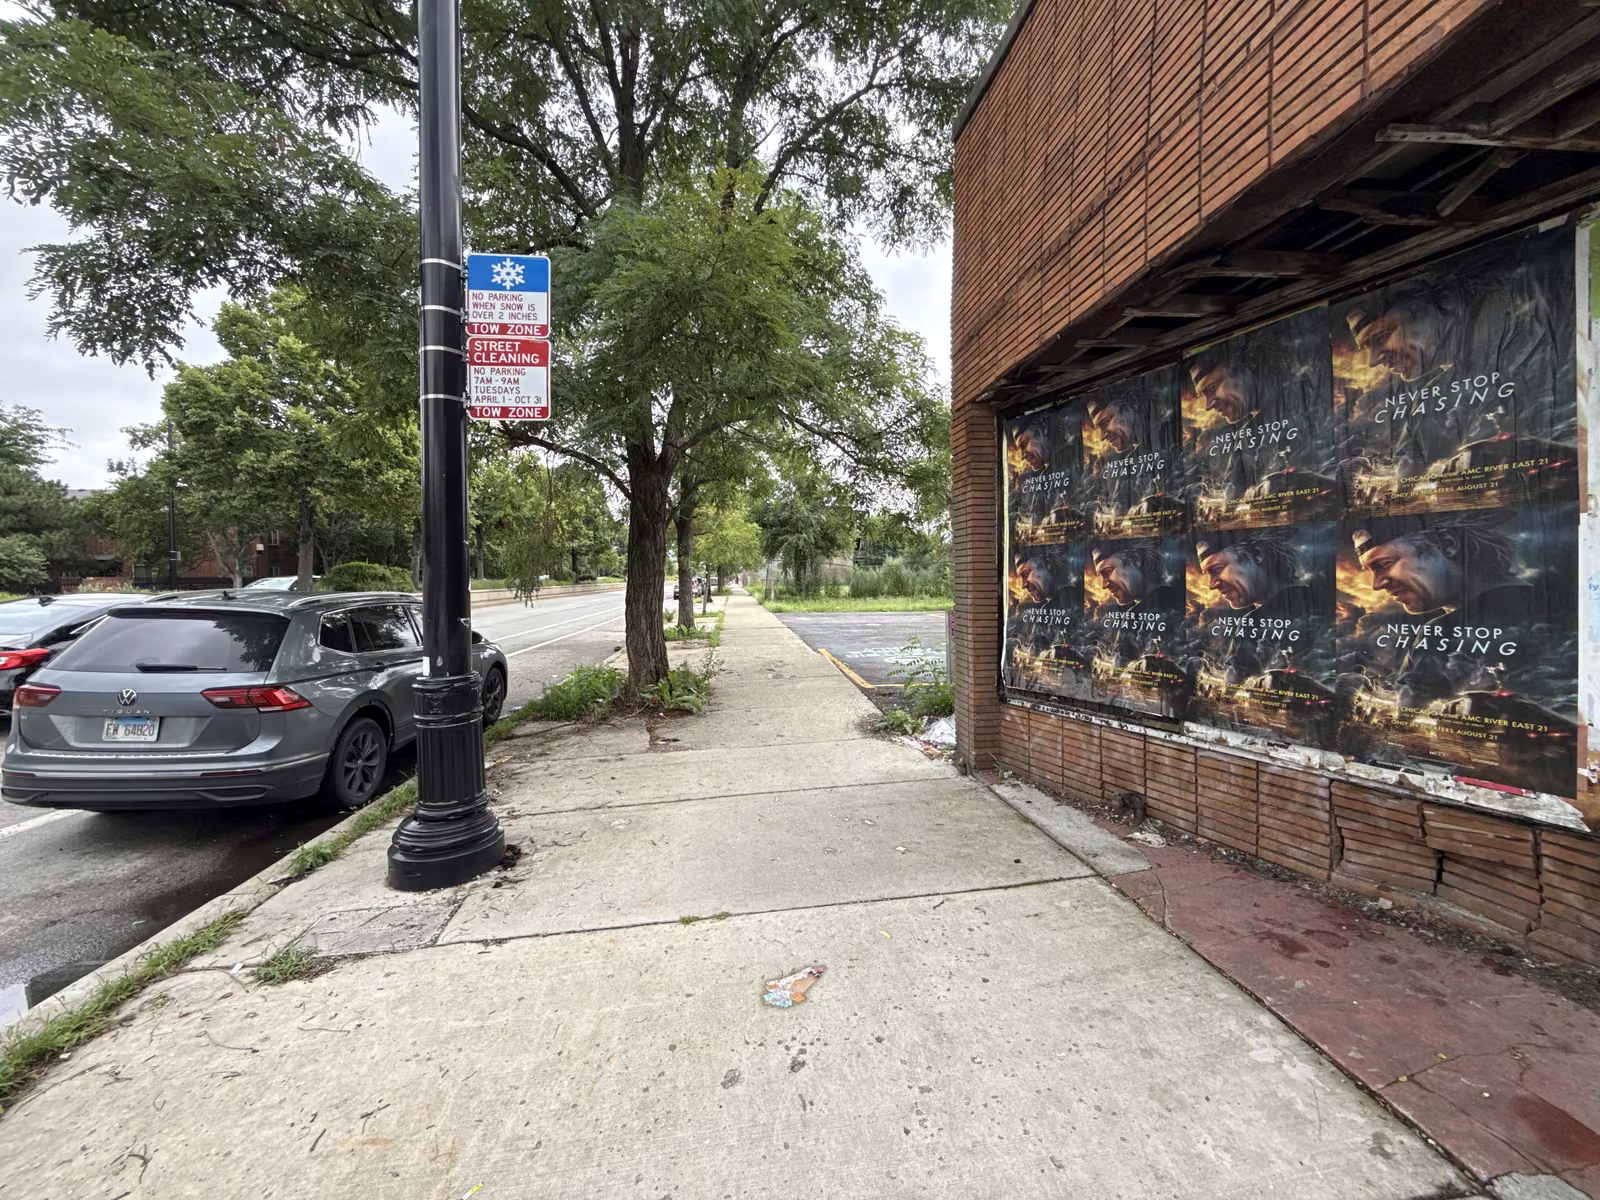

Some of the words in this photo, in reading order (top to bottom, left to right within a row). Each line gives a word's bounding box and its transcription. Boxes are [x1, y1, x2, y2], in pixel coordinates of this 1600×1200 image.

[472, 293, 483, 301] NO
[488, 293, 523, 302] PARKING
[472, 302, 496, 310] WHEN
[500, 303, 523, 311] SNOW
[472, 311, 494, 319] OVER
[498, 312, 504, 320] 2
[508, 312, 538, 321] INCHES
[472, 324, 500, 334] TOW
[507, 325, 542, 335] ZONE
[474, 341, 521, 352] STREET
[474, 352, 540, 364] CLEANING
[473, 367, 486, 375] NO
[490, 368, 526, 376] PARKING
[474, 377, 493, 385] 7AM
[501, 377, 520, 385] 9AM
[474, 386, 521, 395] TUESDAYS
[1385, 386, 1441, 408] NEVER
[1450, 372, 1501, 393] STOP
[474, 395, 500, 404] APRIL
[514, 395, 531, 404] OCT
[534, 396, 542, 405] 31
[1374, 382, 1516, 424] CHASING
[474, 407, 502, 417] TOW
[508, 407, 542, 418] ZONE
[1215, 428, 1252, 444] NEVER
[1257, 419, 1289, 434] STOP
[1209, 428, 1298, 456] CHASING
[1106, 457, 1134, 469] NEVER
[1138, 452, 1159, 463] STOP
[1102, 459, 1165, 479] CHASING
[1400, 472, 1438, 483] CHICAGO
[1461, 467, 1482, 475] AMC
[1484, 463, 1509, 472] RIVER
[1512, 460, 1536, 469] EAST
[1538, 458, 1549, 466] 21
[1024, 475, 1046, 485] NEVER
[1048, 471, 1065, 480] STOP
[1022, 477, 1070, 493] CHASING
[1390, 491, 1408, 499] ONLY
[1456, 482, 1487, 492] AUGUST
[1049, 608, 1066, 616] STOP
[1108, 611, 1136, 620] NEVER
[1138, 612, 1161, 621] STOP
[1022, 614, 1071, 625] CHASING
[1103, 618, 1167, 631] CHASING
[1218, 617, 1254, 627] NEVER
[1259, 618, 1291, 628] STOP
[1211, 625, 1301, 641] CHASING
[1386, 623, 1443, 636] NEVER
[1452, 625, 1503, 639] STOP
[1376, 634, 1517, 656] CHASING
[1295, 691, 1311, 699] EAST
[1400, 706, 1437, 716] CHICAGO
[1484, 718, 1509, 728] RIVER
[1512, 721, 1535, 731] EAST
[1537, 724, 1548, 732] 21
[1456, 729, 1487, 739] AUGUST
